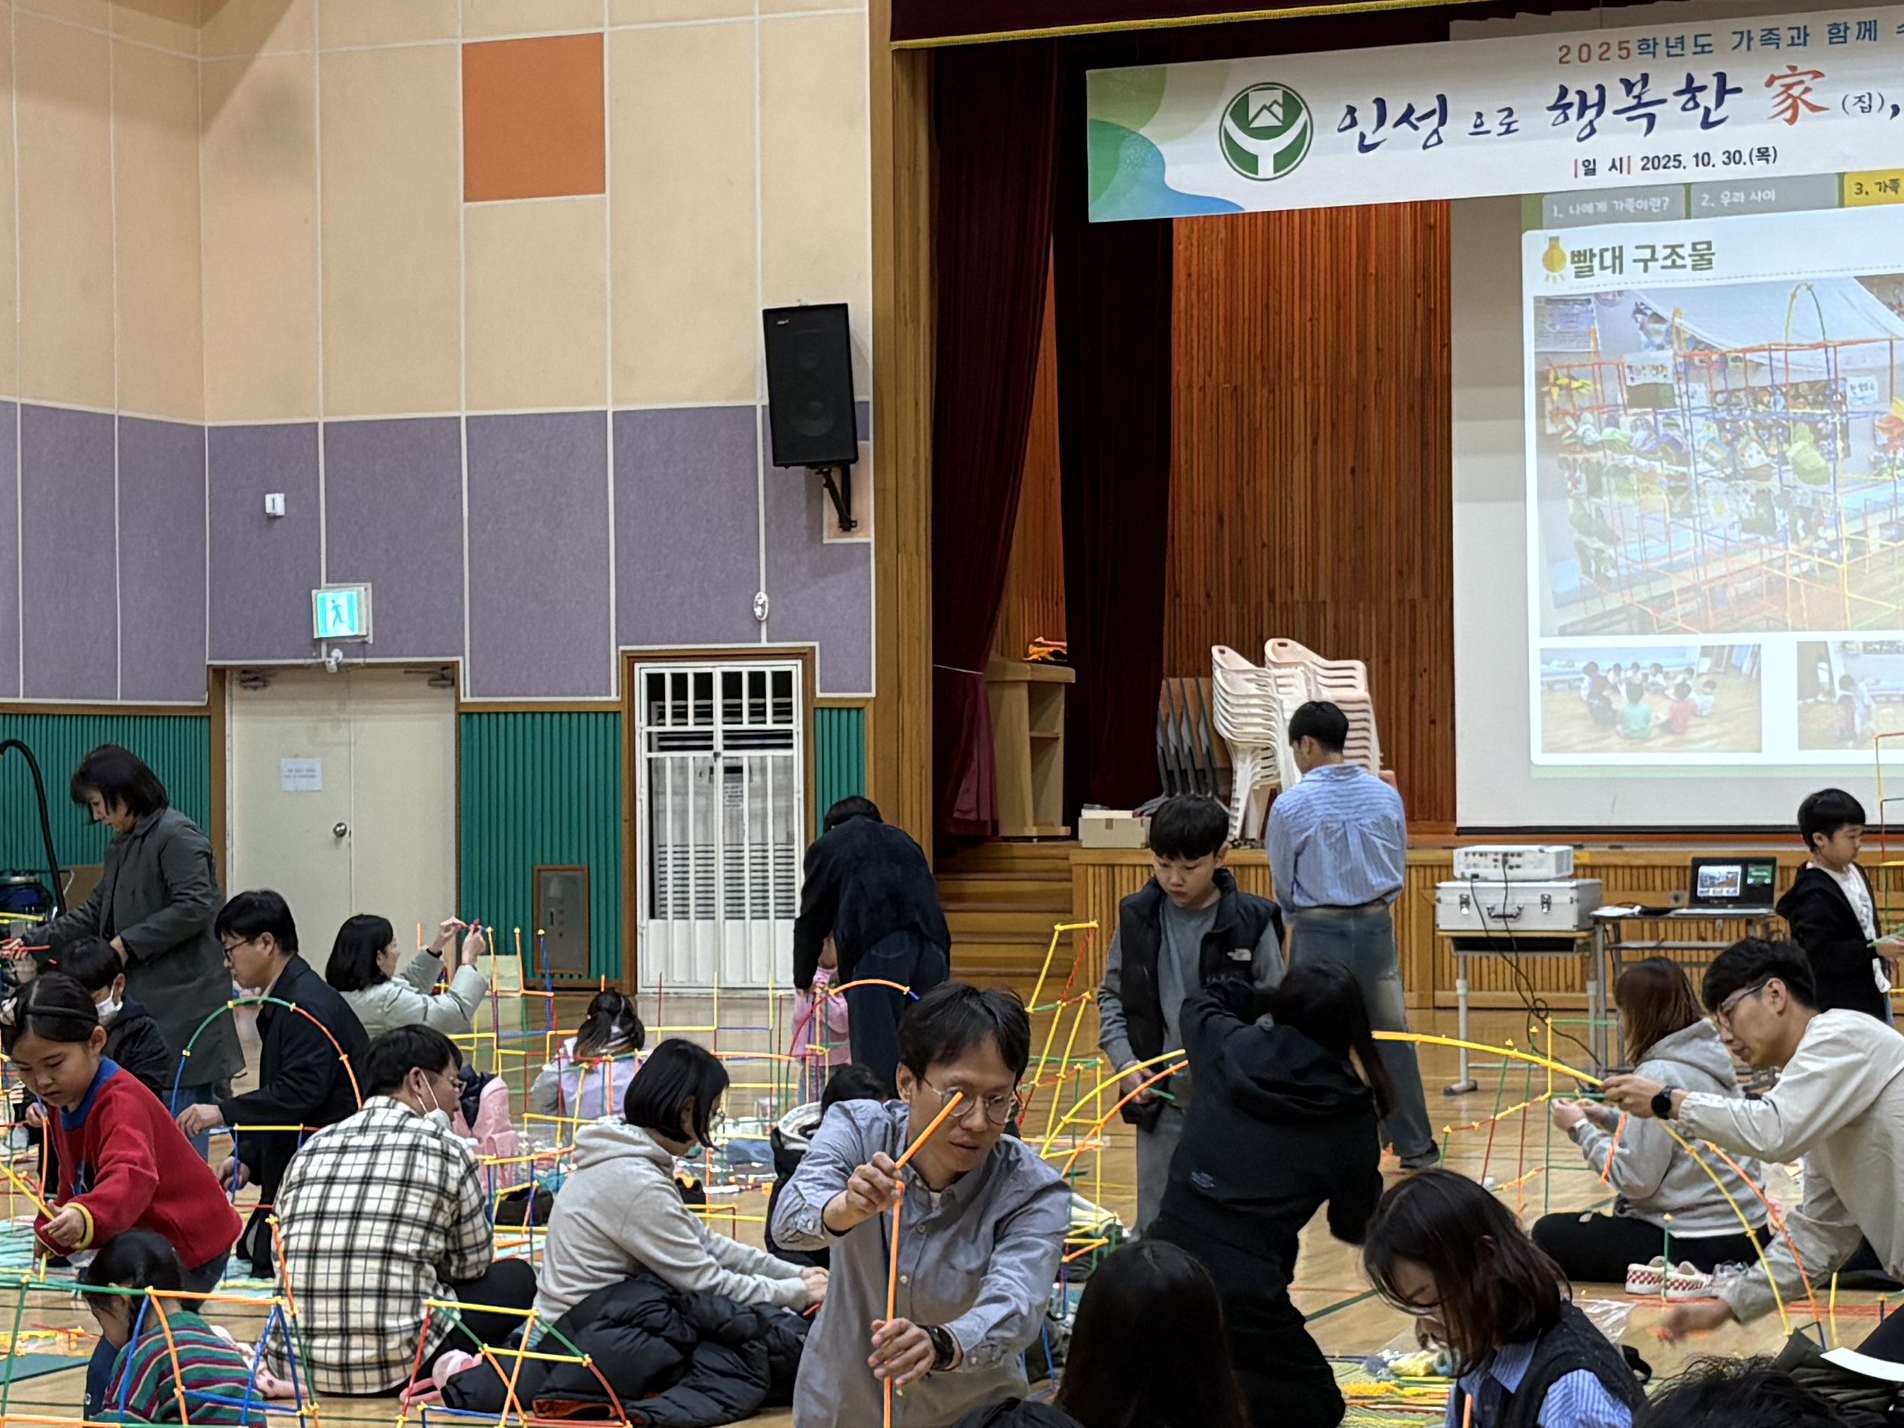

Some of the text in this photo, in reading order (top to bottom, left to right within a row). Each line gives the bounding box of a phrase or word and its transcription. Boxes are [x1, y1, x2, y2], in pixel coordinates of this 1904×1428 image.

[1556, 31, 1716, 67] 2025학년도
[1730, 21, 1812, 54] 가족과
[1826, 17, 1880, 47] 함께
[1545, 69, 1744, 144] 행복한
[1639, 154, 1688, 173] 2025.
[1693, 152, 1717, 170] 10.
[1721, 145, 1778, 169] 30.(목)
[1700, 193, 1716, 207] 2.
[1748, 189, 1776, 203] 사이
[1854, 182, 1870, 196] 3.
[1873, 176, 1900, 195] 가족
[1569, 239, 1716, 279] 빨대 구조물
